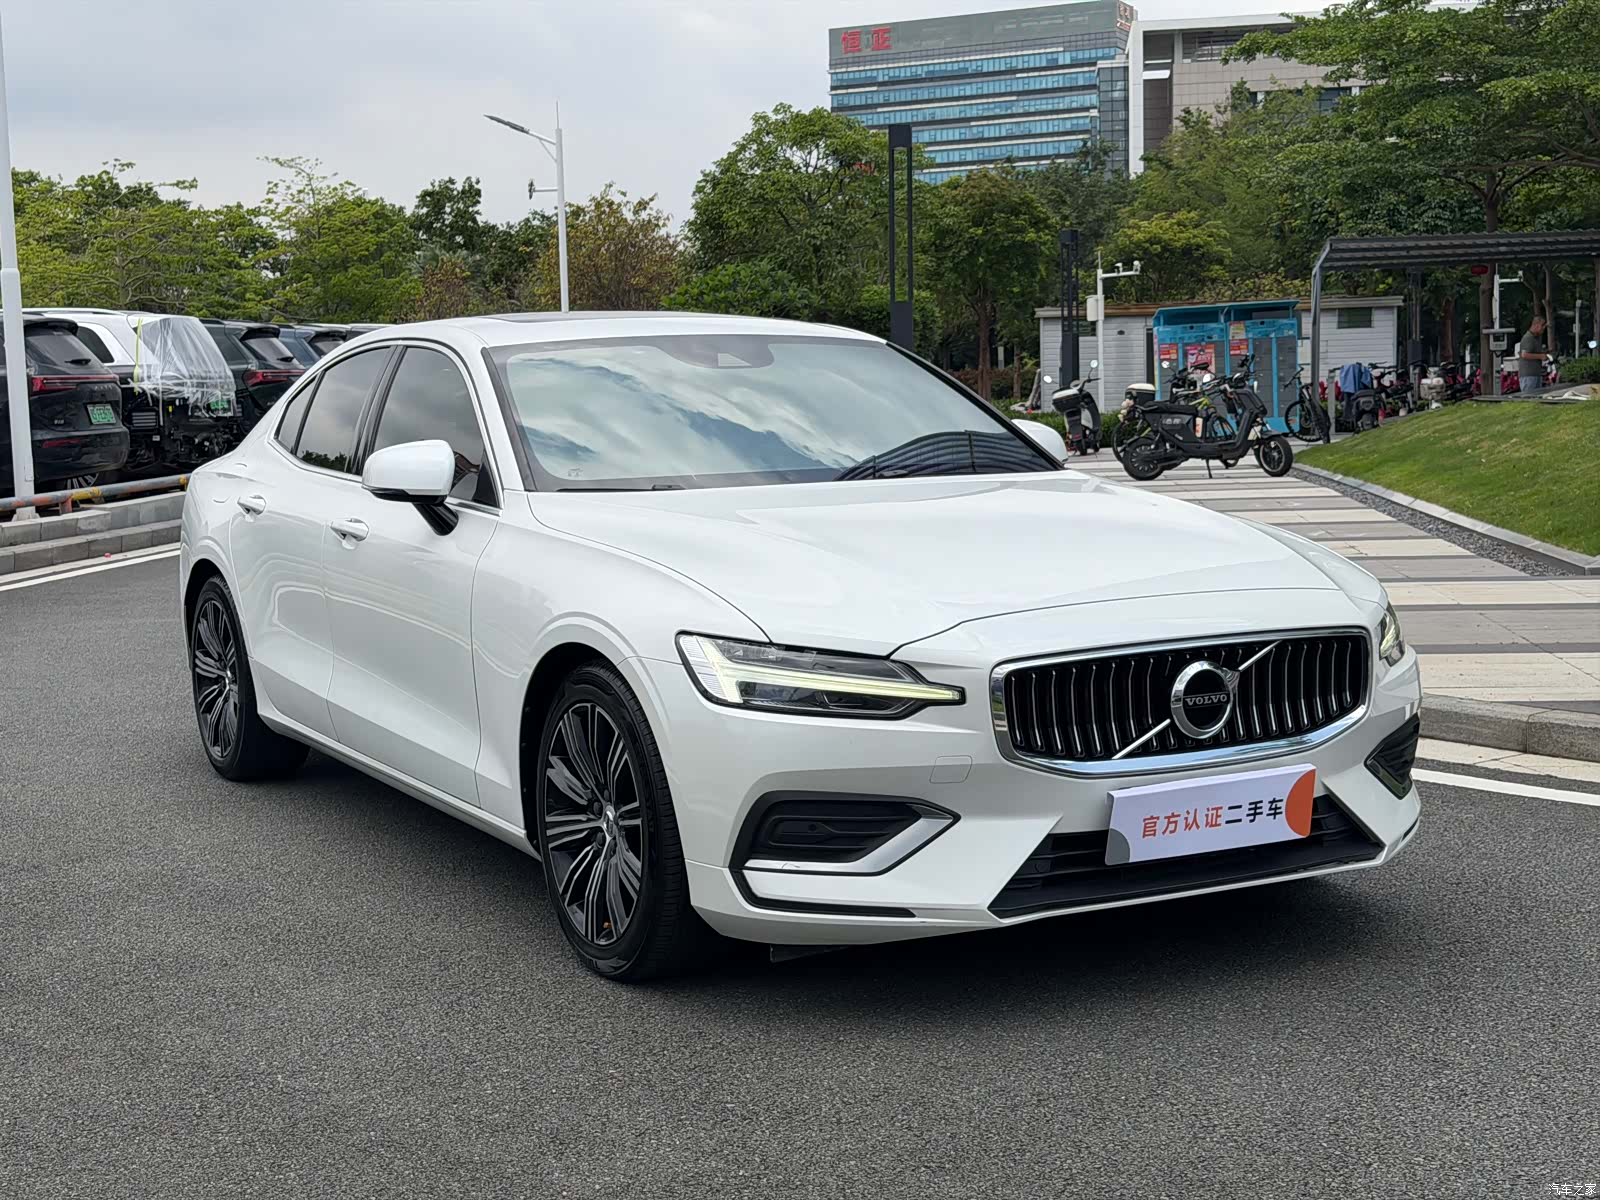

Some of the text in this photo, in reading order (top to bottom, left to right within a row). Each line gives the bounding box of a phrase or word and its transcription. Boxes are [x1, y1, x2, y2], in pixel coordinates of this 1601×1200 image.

[1185, 694, 1227, 705] VOLVO
[1142, 798, 1283, 838] 官方认证二手车
